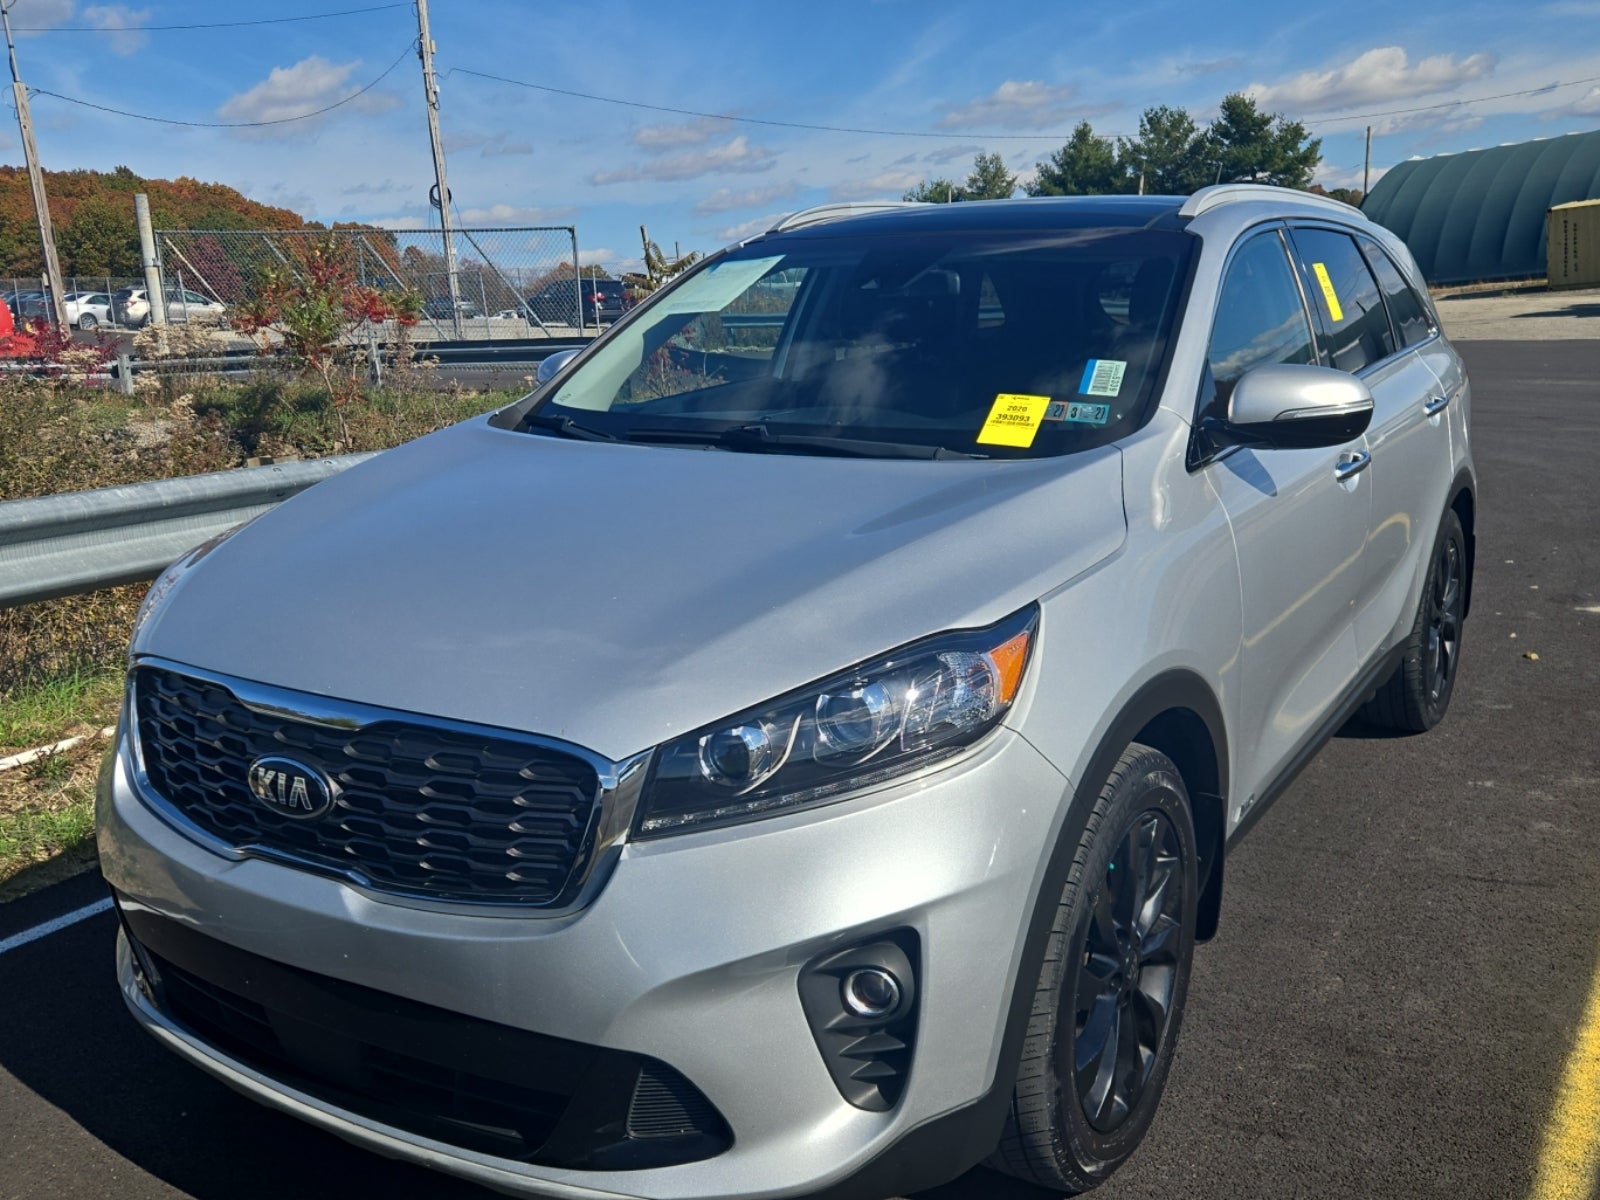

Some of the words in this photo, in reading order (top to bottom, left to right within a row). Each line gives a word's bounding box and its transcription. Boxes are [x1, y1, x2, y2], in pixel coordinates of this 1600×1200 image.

[995, 413, 1031, 422] 393093
[1070, 406, 1078, 419] 3
[1095, 406, 1106, 420] 27
[258, 767, 313, 811] KIA
